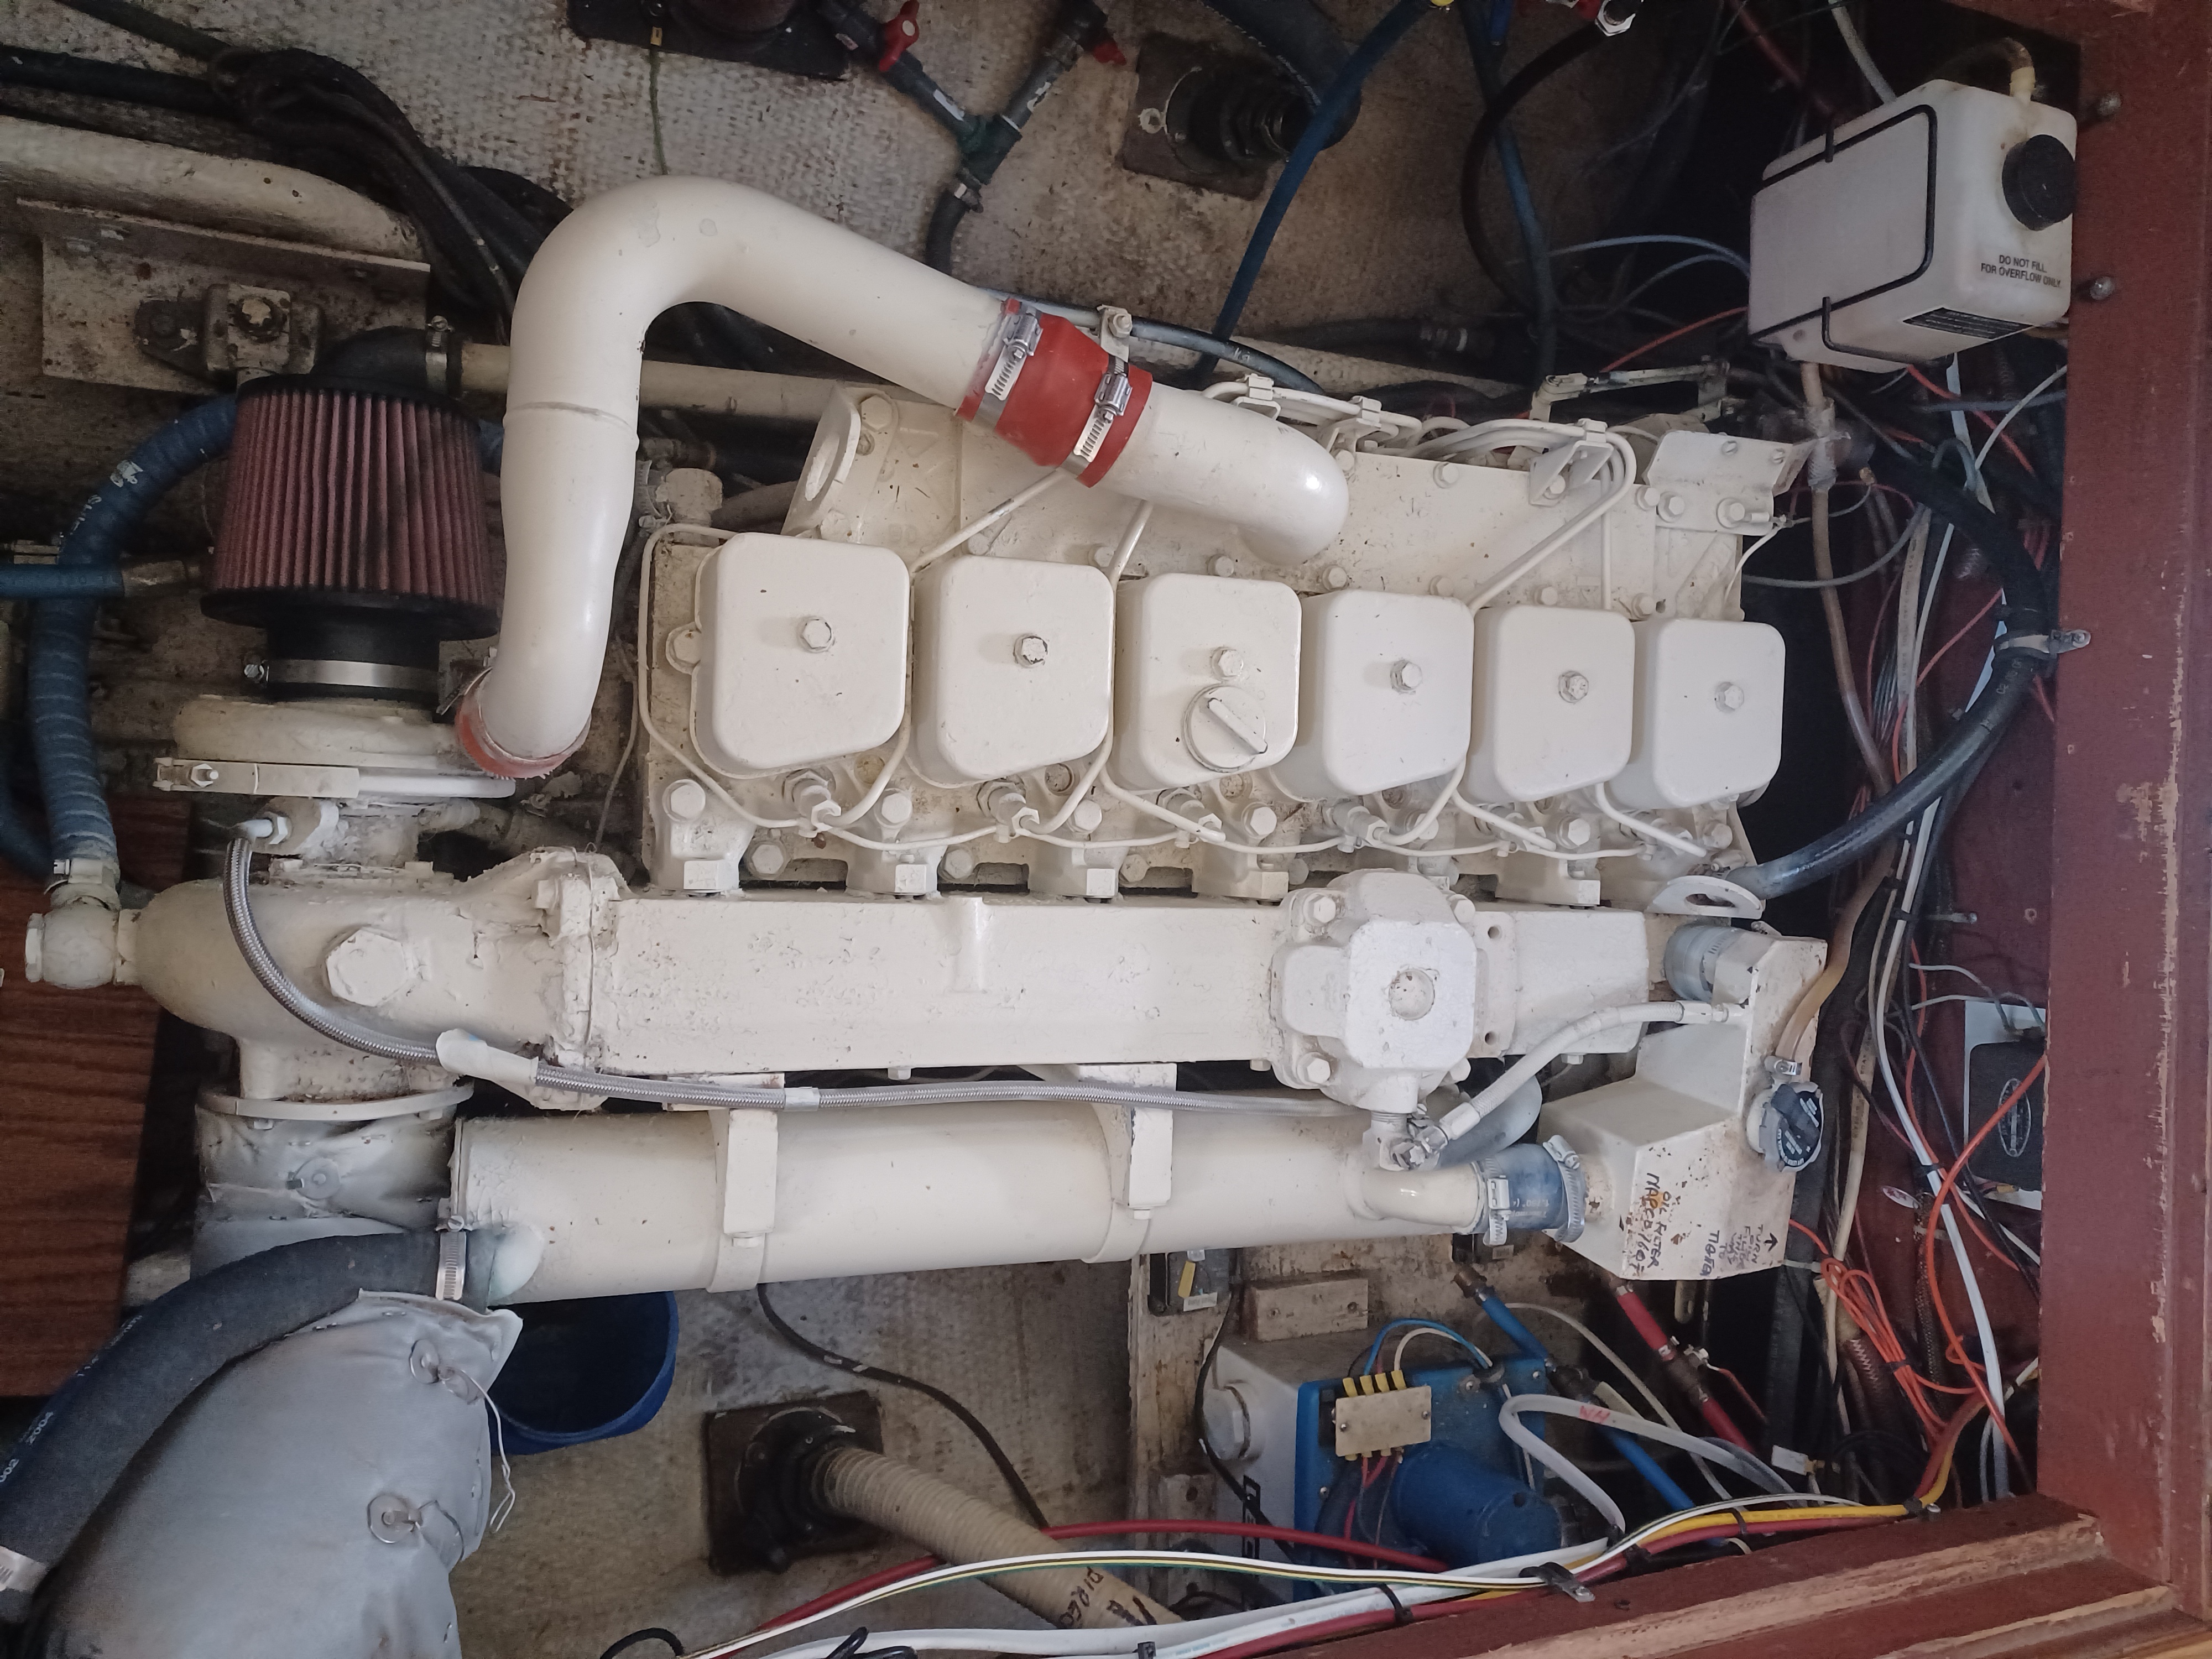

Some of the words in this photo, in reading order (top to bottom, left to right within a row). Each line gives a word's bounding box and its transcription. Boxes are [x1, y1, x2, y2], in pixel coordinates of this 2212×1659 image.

[1981, 263, 1996, 274] FOR
[1999, 266, 2042, 283] OVERFLOW
[2043, 275, 2061, 288] ONLY
[1999, 255, 2011, 265] DO
[2013, 257, 2030, 268] NOT
[2031, 260, 2047, 273] FILL
[1660, 1191, 1672, 1214] OIL
[1647, 1221, 1667, 1268] FILTER
[1751, 1224, 1763, 1264] TURN
